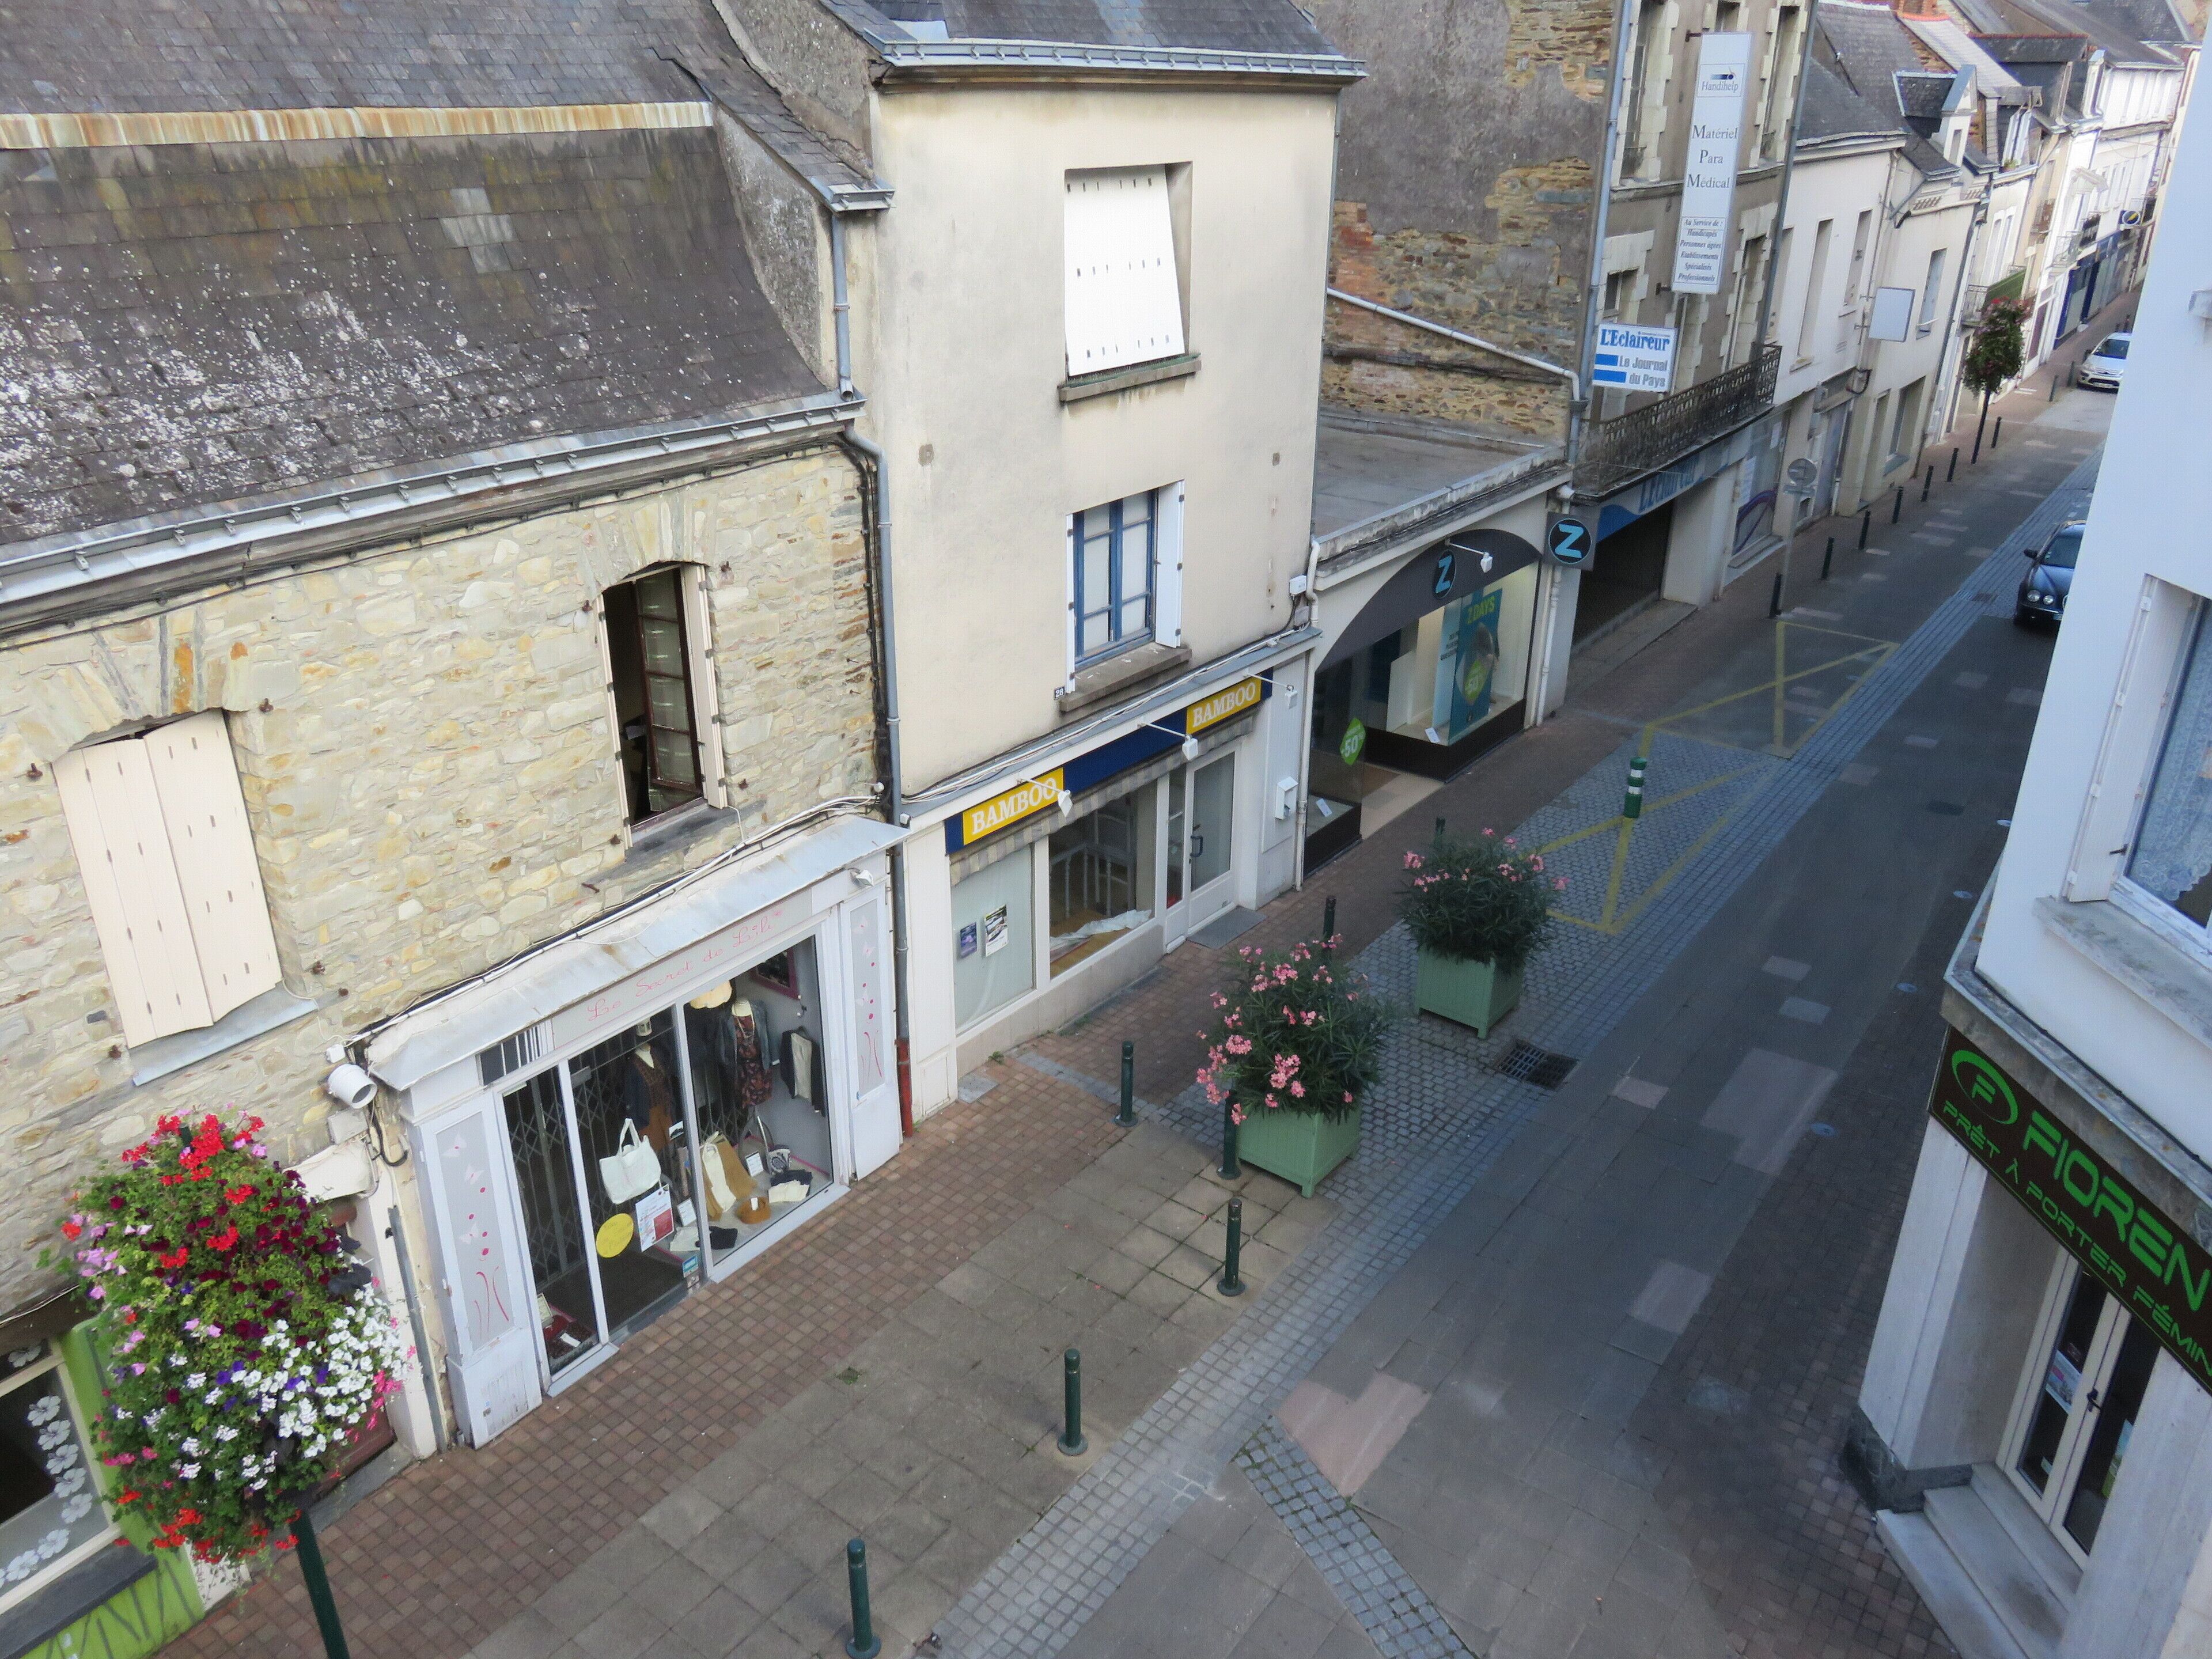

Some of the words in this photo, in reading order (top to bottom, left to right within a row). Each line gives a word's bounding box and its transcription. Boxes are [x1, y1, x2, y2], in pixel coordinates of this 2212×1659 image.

[1702, 81, 1738, 93] Handihelp
[1692, 124, 1737, 139] Matériel
[1699, 149, 1724, 164] Para
[1687, 173, 1730, 188] Médical
[1680, 240, 1706, 248] Personnes
[1678, 273, 1715, 282] Professionnels
[1600, 329, 1670, 351] L'Eclaireur
[1619, 355, 1630, 368] Le
[1632, 357, 1668, 372] Journal
[1629, 373, 1641, 384] du
[1643, 374, 1666, 388] Pays
[1555, 522, 1585, 559] Z
[1435, 554, 1452, 594] Z
[1055, 688, 1064, 698] 28
[1192, 680, 1256, 729] BAMBOO
[971, 778, 1057, 836] BAMBOO
[587, 998, 622, 1021] Le
[703, 949, 724, 962] de
[1943, 1100, 2001, 1158] PRÊT
[2026, 1181, 2127, 1288] PORTER
[2023, 1110, 2210, 1312] FIOREN
